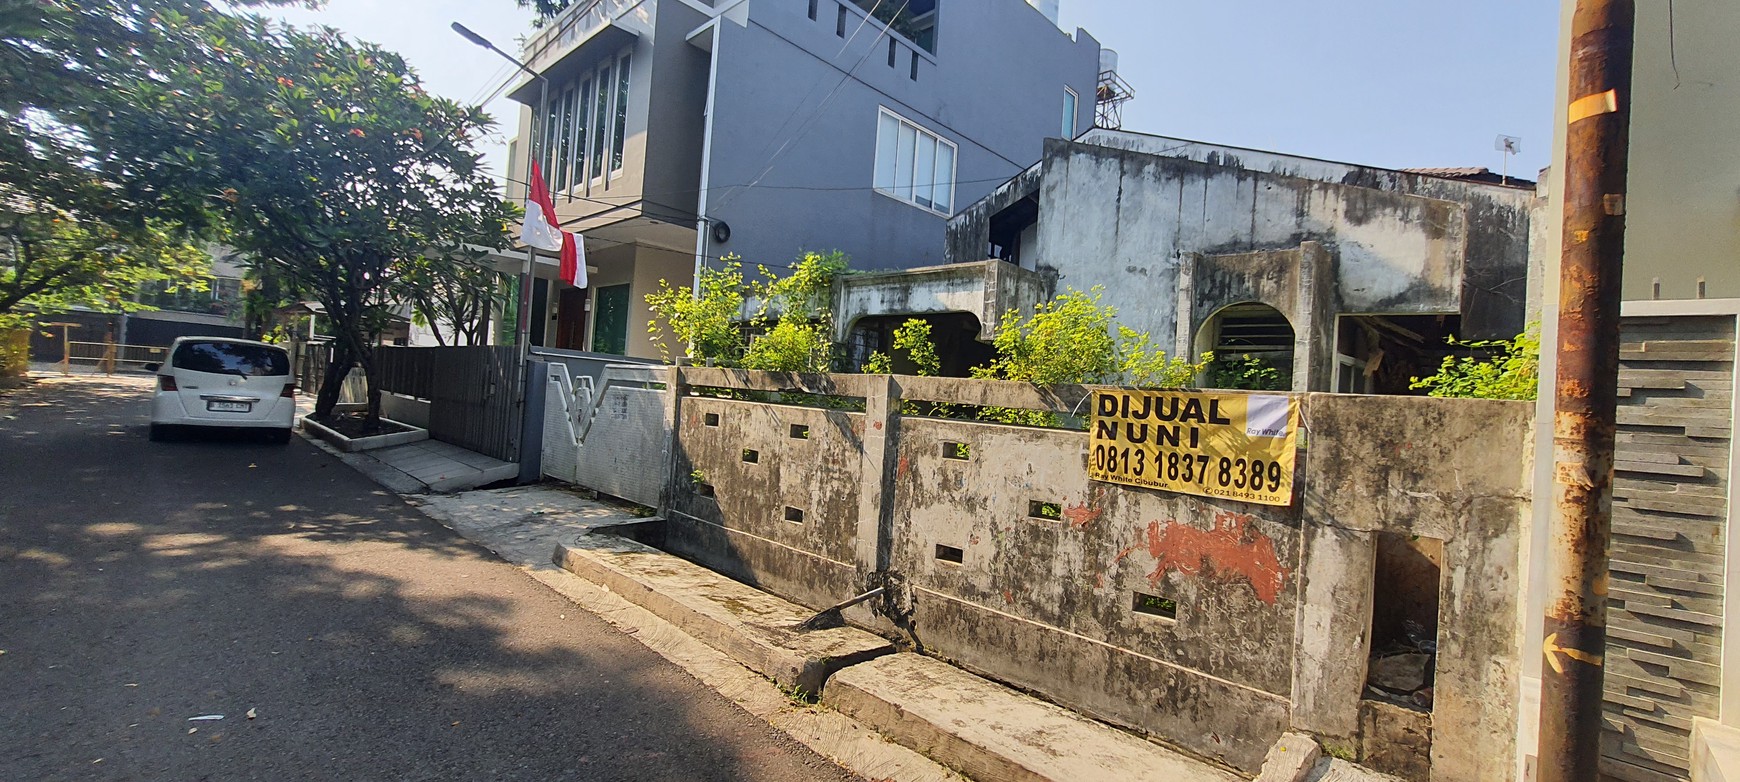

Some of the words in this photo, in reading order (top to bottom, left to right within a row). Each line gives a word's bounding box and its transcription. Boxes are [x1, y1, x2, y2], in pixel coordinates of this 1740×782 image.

[1098, 394, 1231, 425] DIJUAL
[1096, 420, 1199, 449] NUNI
[1247, 427, 1261, 436] Ray
[1096, 444, 1145, 476] 0813
[1155, 450, 1209, 484] 1837
[1218, 456, 1281, 493] 8389
[1095, 472, 1109, 481] Ray
[1110, 475, 1133, 483] White
[1134, 478, 1168, 488] Cibubur
[1213, 488, 1231, 497] 021
[1232, 491, 1256, 500] 8493
